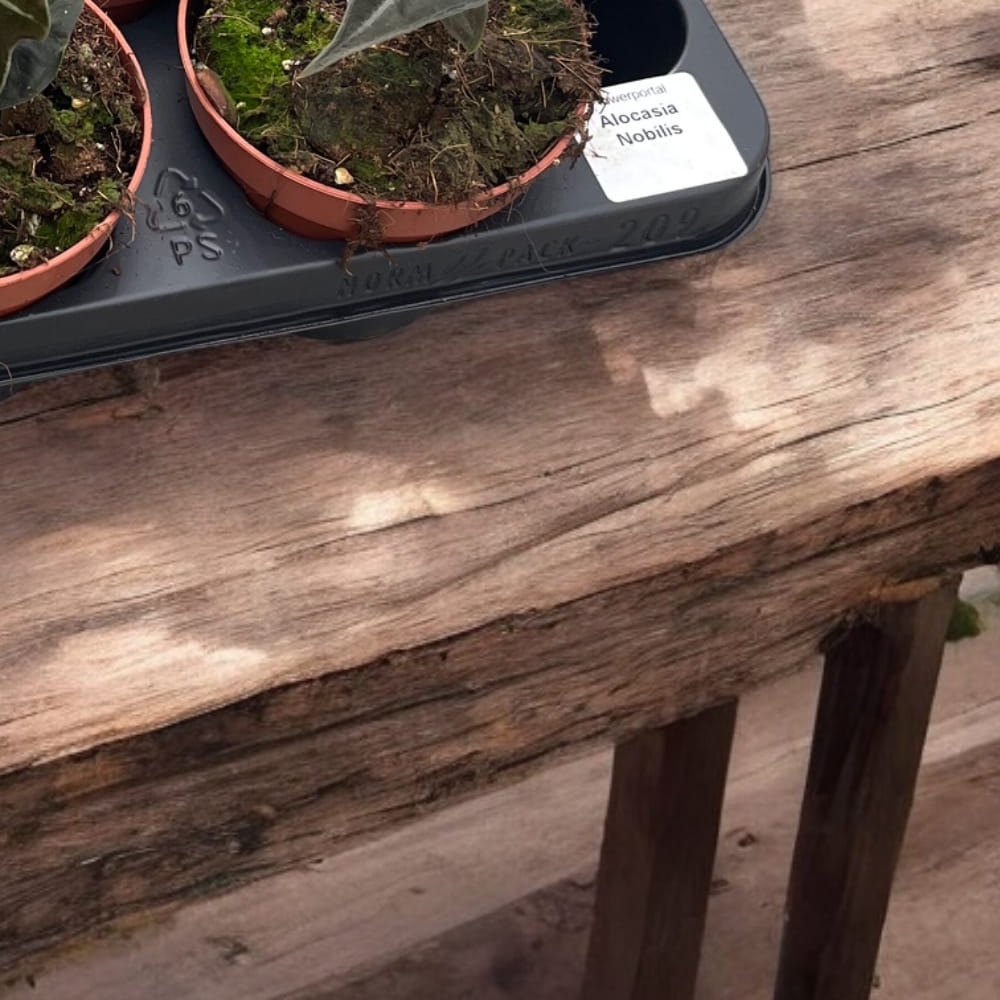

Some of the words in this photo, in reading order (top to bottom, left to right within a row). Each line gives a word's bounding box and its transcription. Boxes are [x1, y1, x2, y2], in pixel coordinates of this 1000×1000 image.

[600, 102, 679, 129] Alocasia
[616, 123, 684, 147] Nobilis
[171, 192, 191, 217] 6
[170, 233, 223, 265] PS
